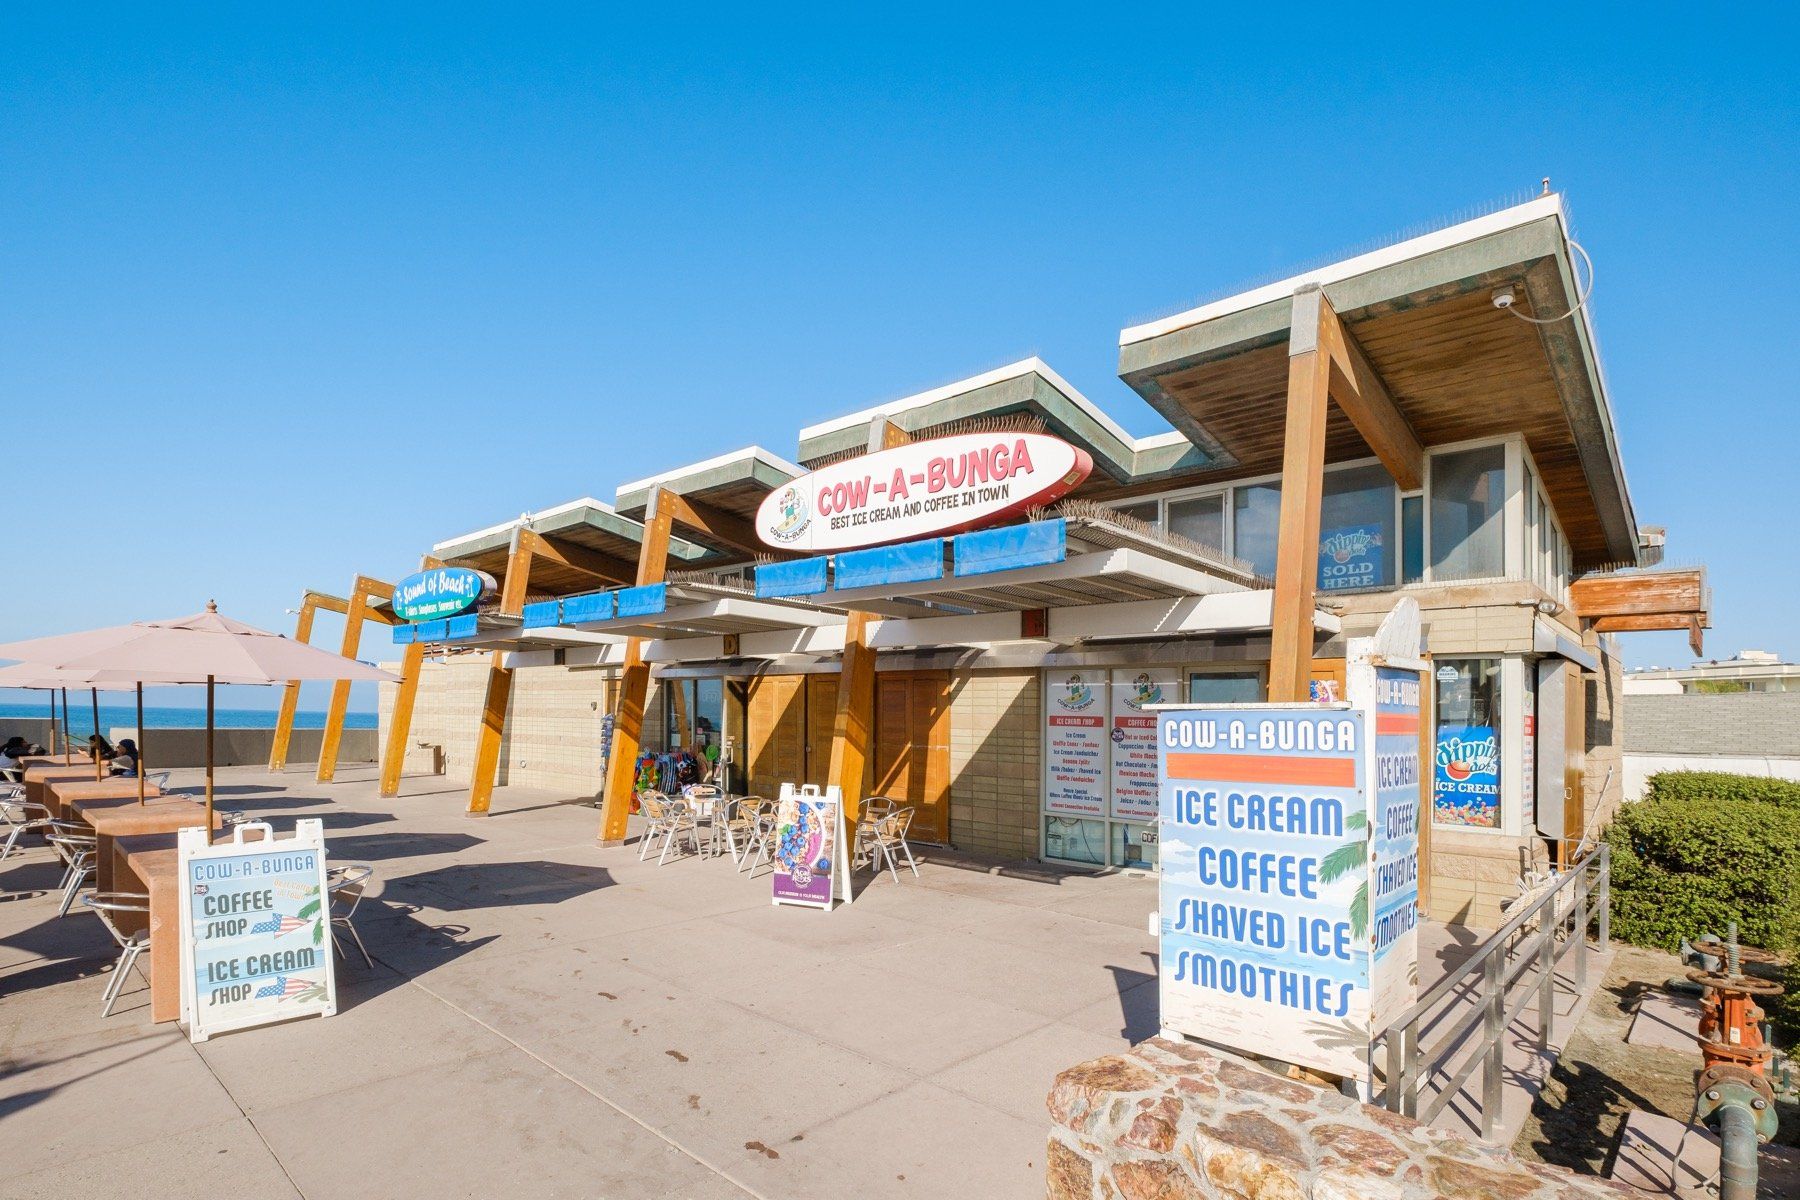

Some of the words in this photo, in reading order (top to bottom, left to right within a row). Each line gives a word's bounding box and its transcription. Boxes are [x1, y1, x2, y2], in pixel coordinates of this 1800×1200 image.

[818, 439, 1034, 516] COW-A-BUNGA
[830, 515, 850, 530] BEST
[852, 511, 868, 527] ICE
[869, 505, 901, 523] CREAM
[903, 500, 922, 517] AND
[924, 494, 960, 513] COFFEE
[962, 490, 976, 507] IN
[977, 483, 1009, 504] TOWN
[770, 519, 811, 540] COW-A-BUNGA
[1322, 574, 1375, 590] HERE
[1323, 562, 1374, 577] SOLD
[403, 574, 426, 605] Sound
[428, 572, 437, 597] of
[438, 570, 465, 595] Beach
[1057, 698, 1095, 711] COW-A-BUNGA
[1376, 678, 1420, 707] COW-A-BUNGA
[1065, 718, 1081, 726] CREAM
[1082, 718, 1095, 726] SHOP
[1128, 719, 1146, 727] COFFEE
[1146, 719, 1158, 727] SHO
[1118, 742, 1144, 750] Cappuccino
[1165, 720, 1355, 751] COW-A-BUNGA
[1139, 770, 1155, 778] Mocha
[1377, 756, 1391, 789] ICE
[1394, 755, 1418, 787] CREAM
[1116, 788, 1133, 796] Belgian
[1134, 789, 1152, 797] Waffles
[1457, 783, 1501, 794] CREAM
[1132, 809, 1152, 817] Connection
[1138, 798, 1151, 806] Sodas
[1176, 789, 1217, 827] ICE
[1228, 793, 1343, 837] CREAM
[1386, 802, 1413, 841] COFFEE
[194, 855, 314, 881] COW-A-BUNGA
[1199, 846, 1317, 900] COFFEE
[1376, 857, 1406, 897] SHAVED
[1406, 852, 1417, 883] ICE
[203, 889, 273, 916] COFFEE
[205, 918, 248, 940] SHOP
[1175, 898, 1285, 949] SHAVED
[1298, 916, 1351, 961] ICE
[1374, 900, 1416, 951] SMOOTHIES
[208, 959, 240, 982] ICE
[246, 947, 315, 976] CREAM
[209, 983, 252, 1007] SHOP
[1174, 951, 1353, 1017] SMOOTHIES
